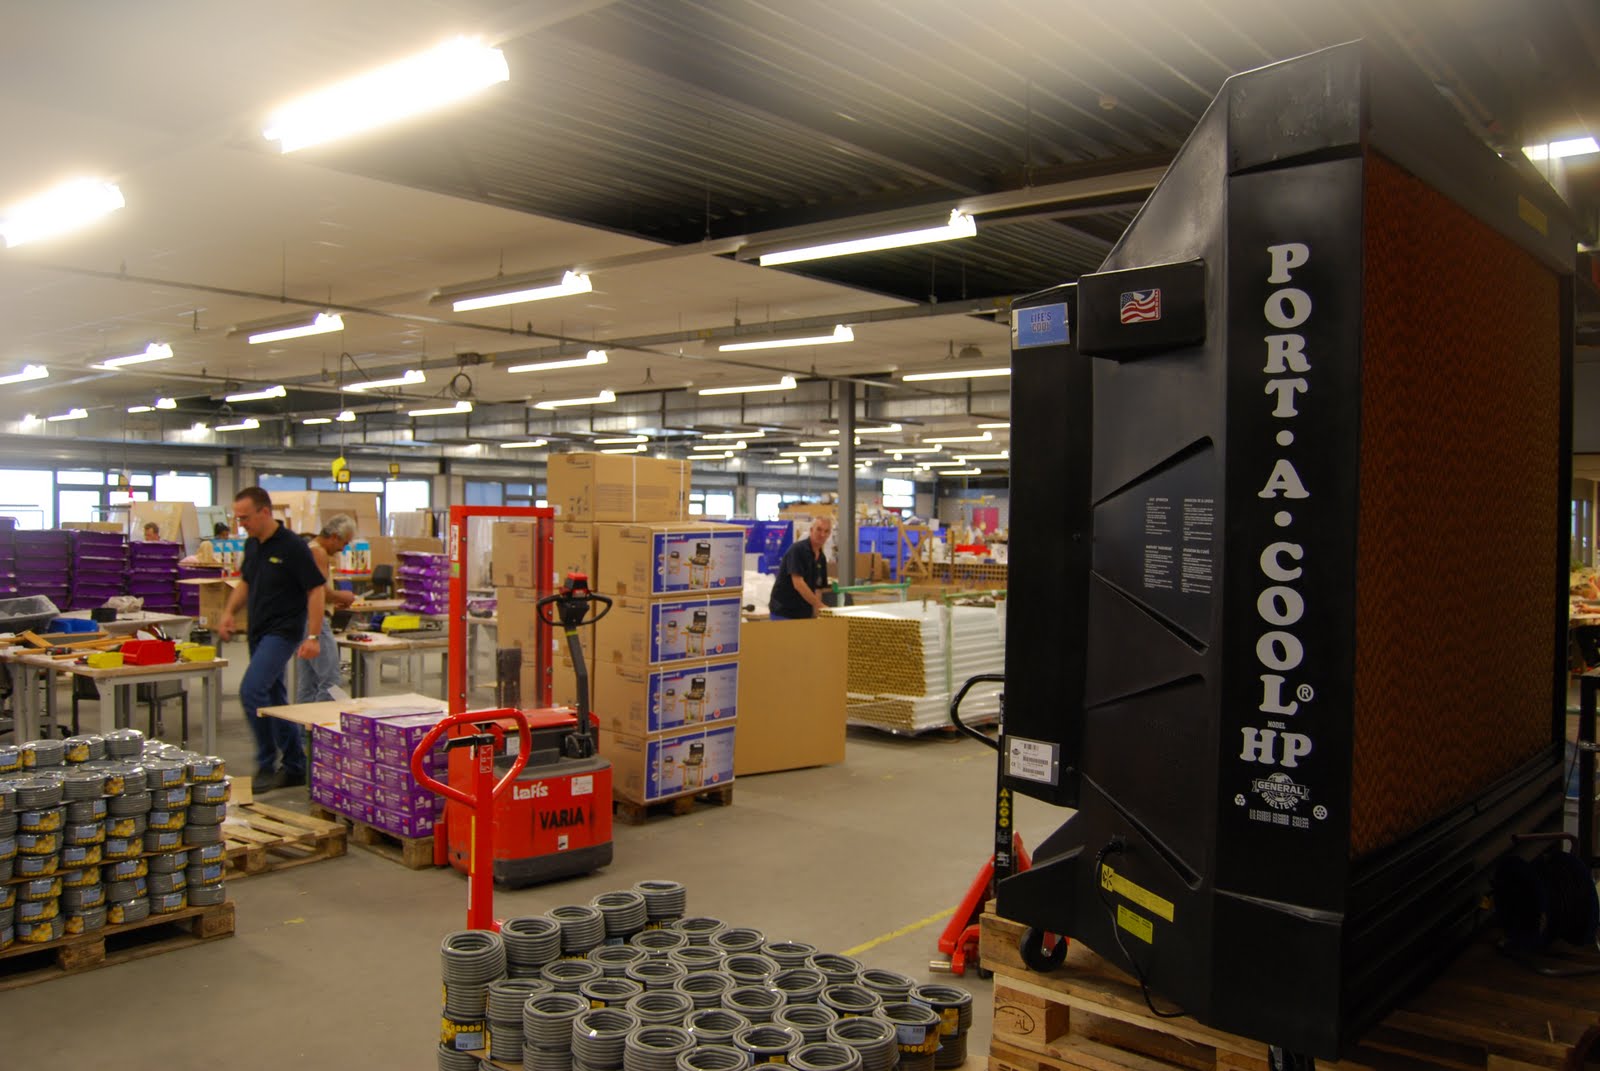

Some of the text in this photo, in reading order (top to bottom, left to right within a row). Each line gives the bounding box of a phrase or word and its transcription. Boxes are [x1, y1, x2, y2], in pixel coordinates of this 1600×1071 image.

[1239, 726, 1313, 768] HP
[1257, 780, 1304, 795] GENERAL
[1261, 791, 1299, 810] SHELTERS
[539, 806, 584, 830] VARIA
